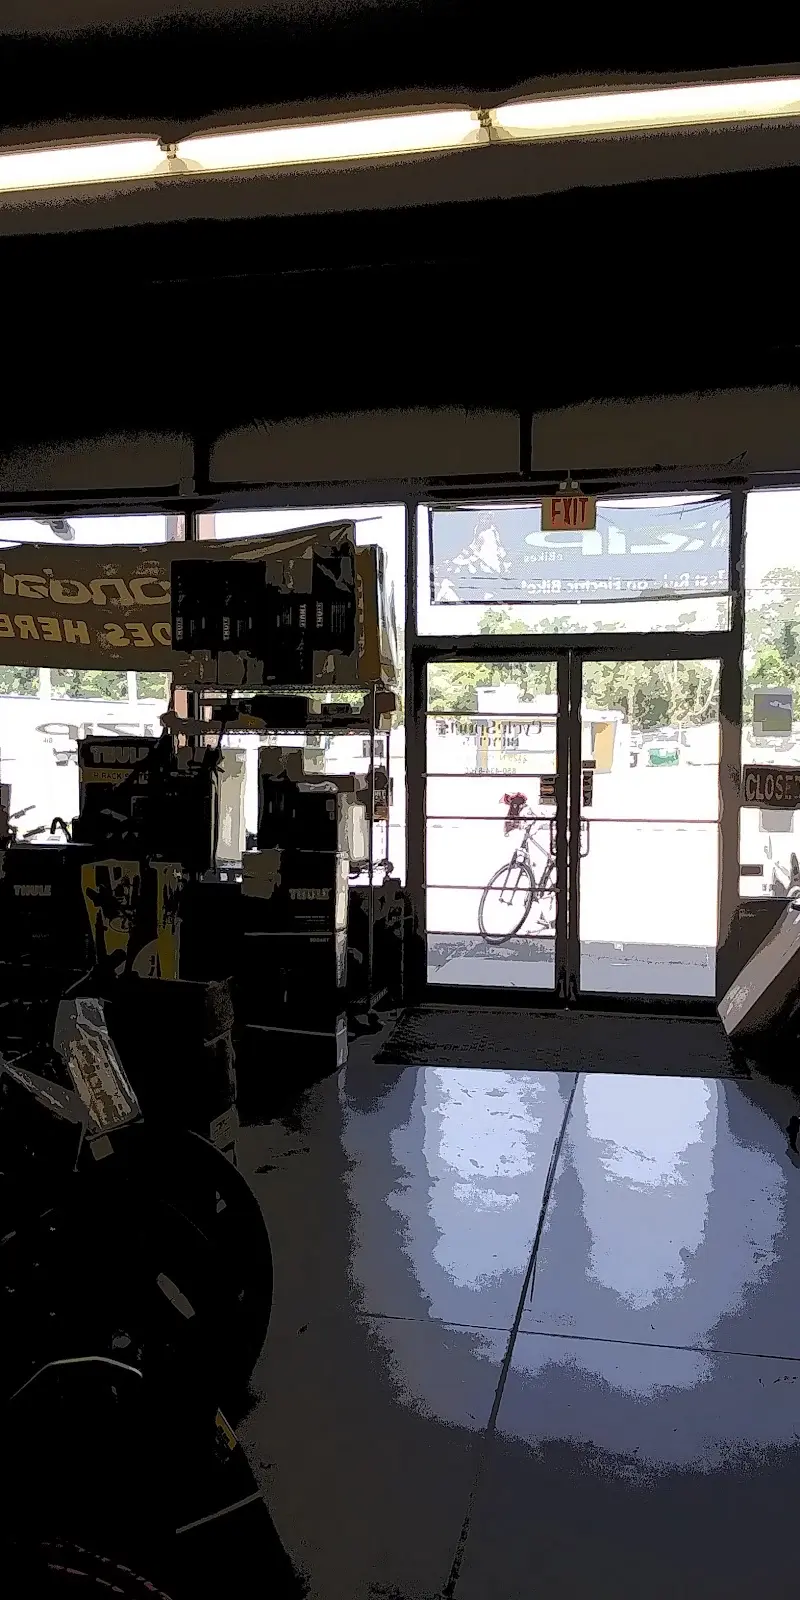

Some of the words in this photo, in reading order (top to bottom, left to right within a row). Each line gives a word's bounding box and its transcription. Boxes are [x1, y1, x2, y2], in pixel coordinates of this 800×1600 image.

[551, 496, 588, 526] EXIT
[101, 772, 123, 780] RACK
[13, 884, 52, 897] THULE
